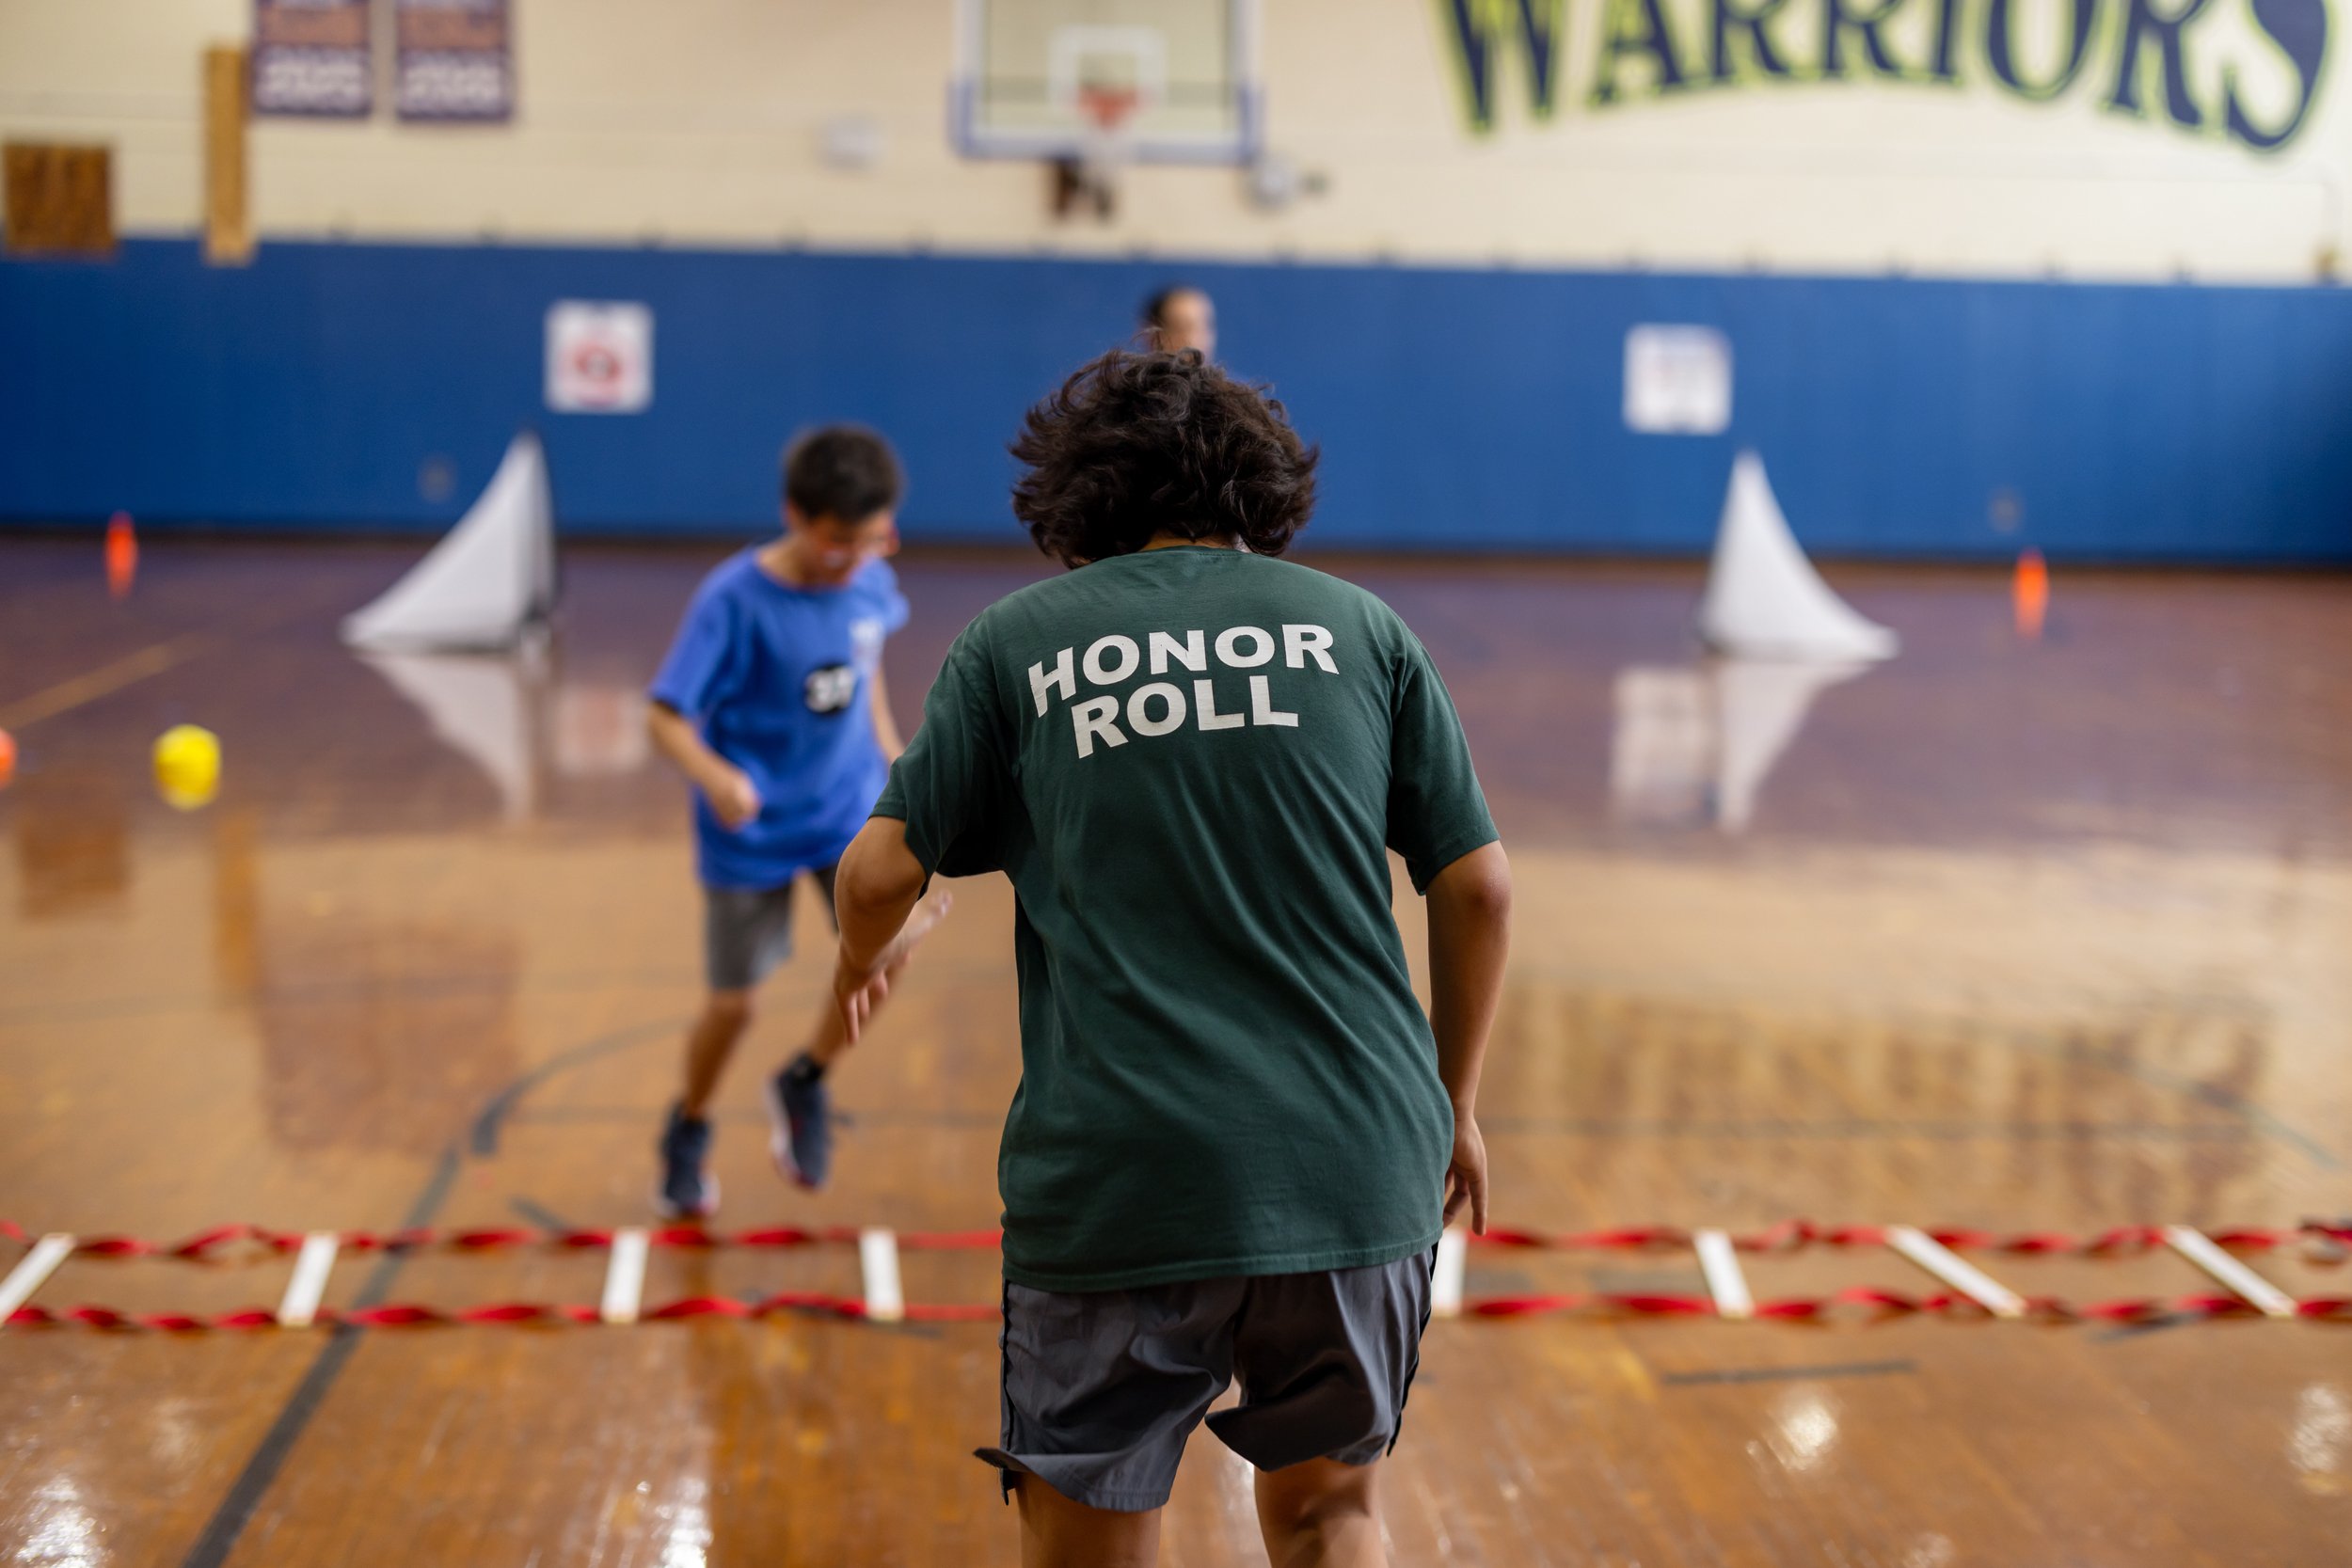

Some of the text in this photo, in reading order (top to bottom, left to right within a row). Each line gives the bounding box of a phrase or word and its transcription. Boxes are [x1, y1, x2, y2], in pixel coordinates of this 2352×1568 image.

[1439, 0, 2329, 150] WARRIORS
[1028, 624, 1340, 718] HONOR
[1071, 674, 1299, 759] ROLL
